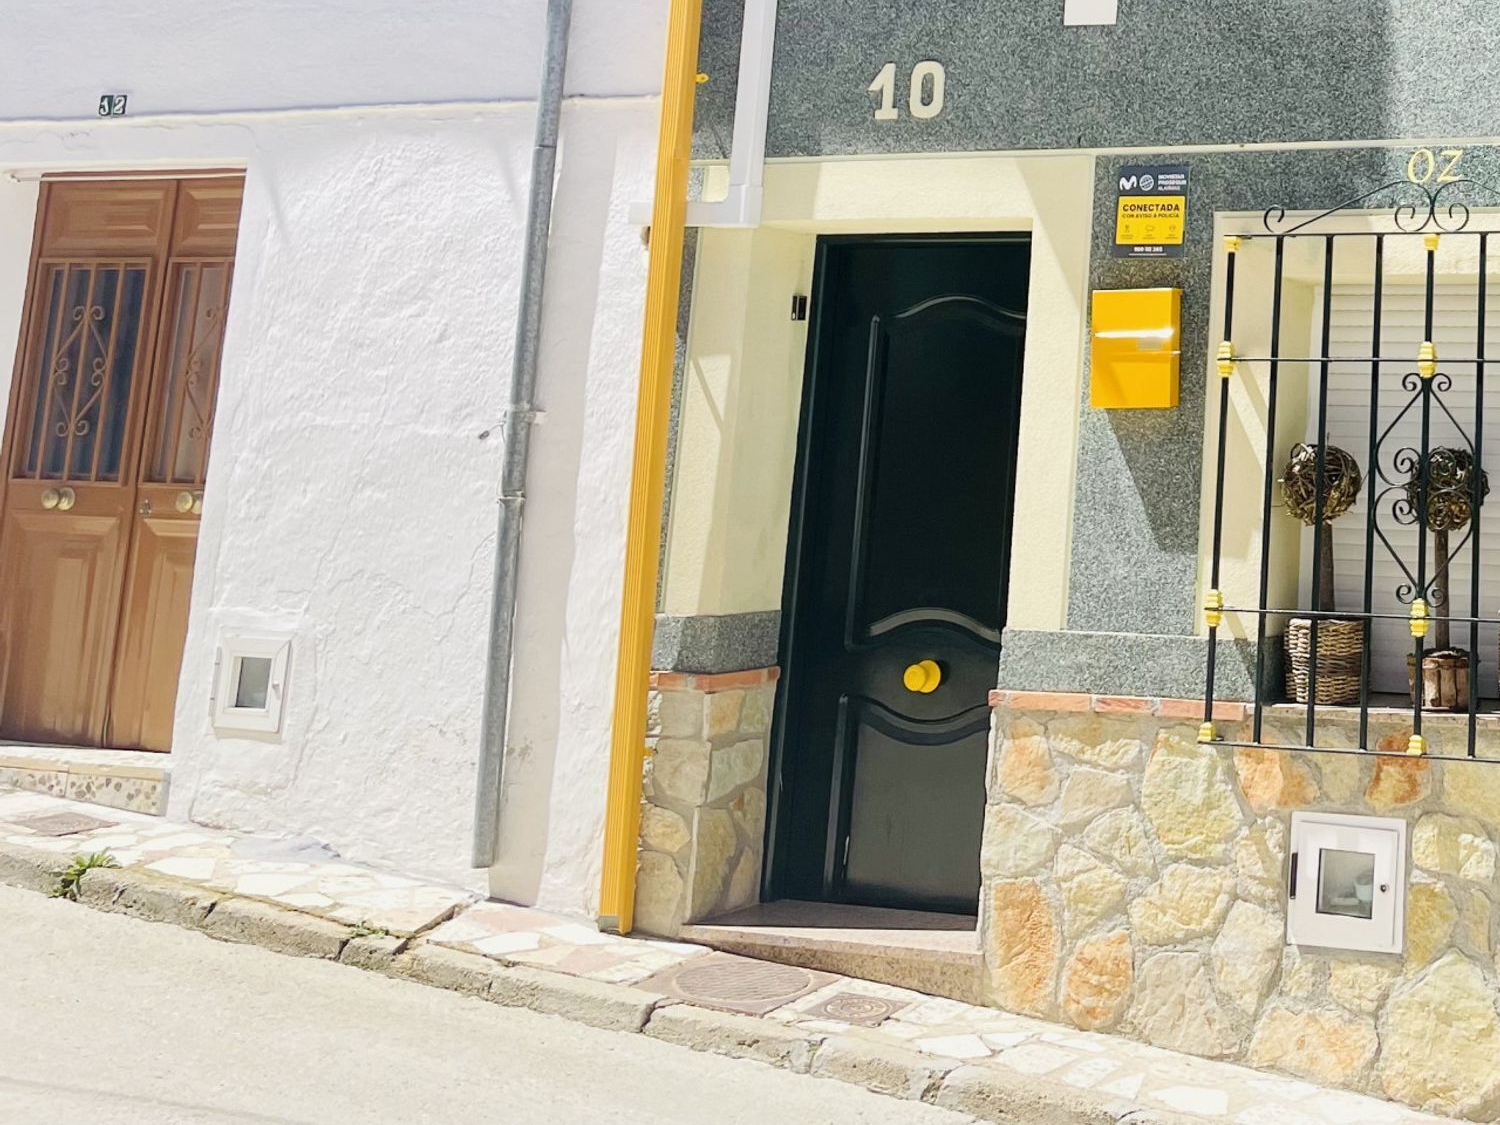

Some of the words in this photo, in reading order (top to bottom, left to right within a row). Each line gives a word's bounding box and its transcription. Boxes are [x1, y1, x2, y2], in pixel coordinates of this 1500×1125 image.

[868, 61, 946, 120] 10
[1407, 148, 1464, 184] OZ
[1122, 203, 1180, 212] CONECTADA
